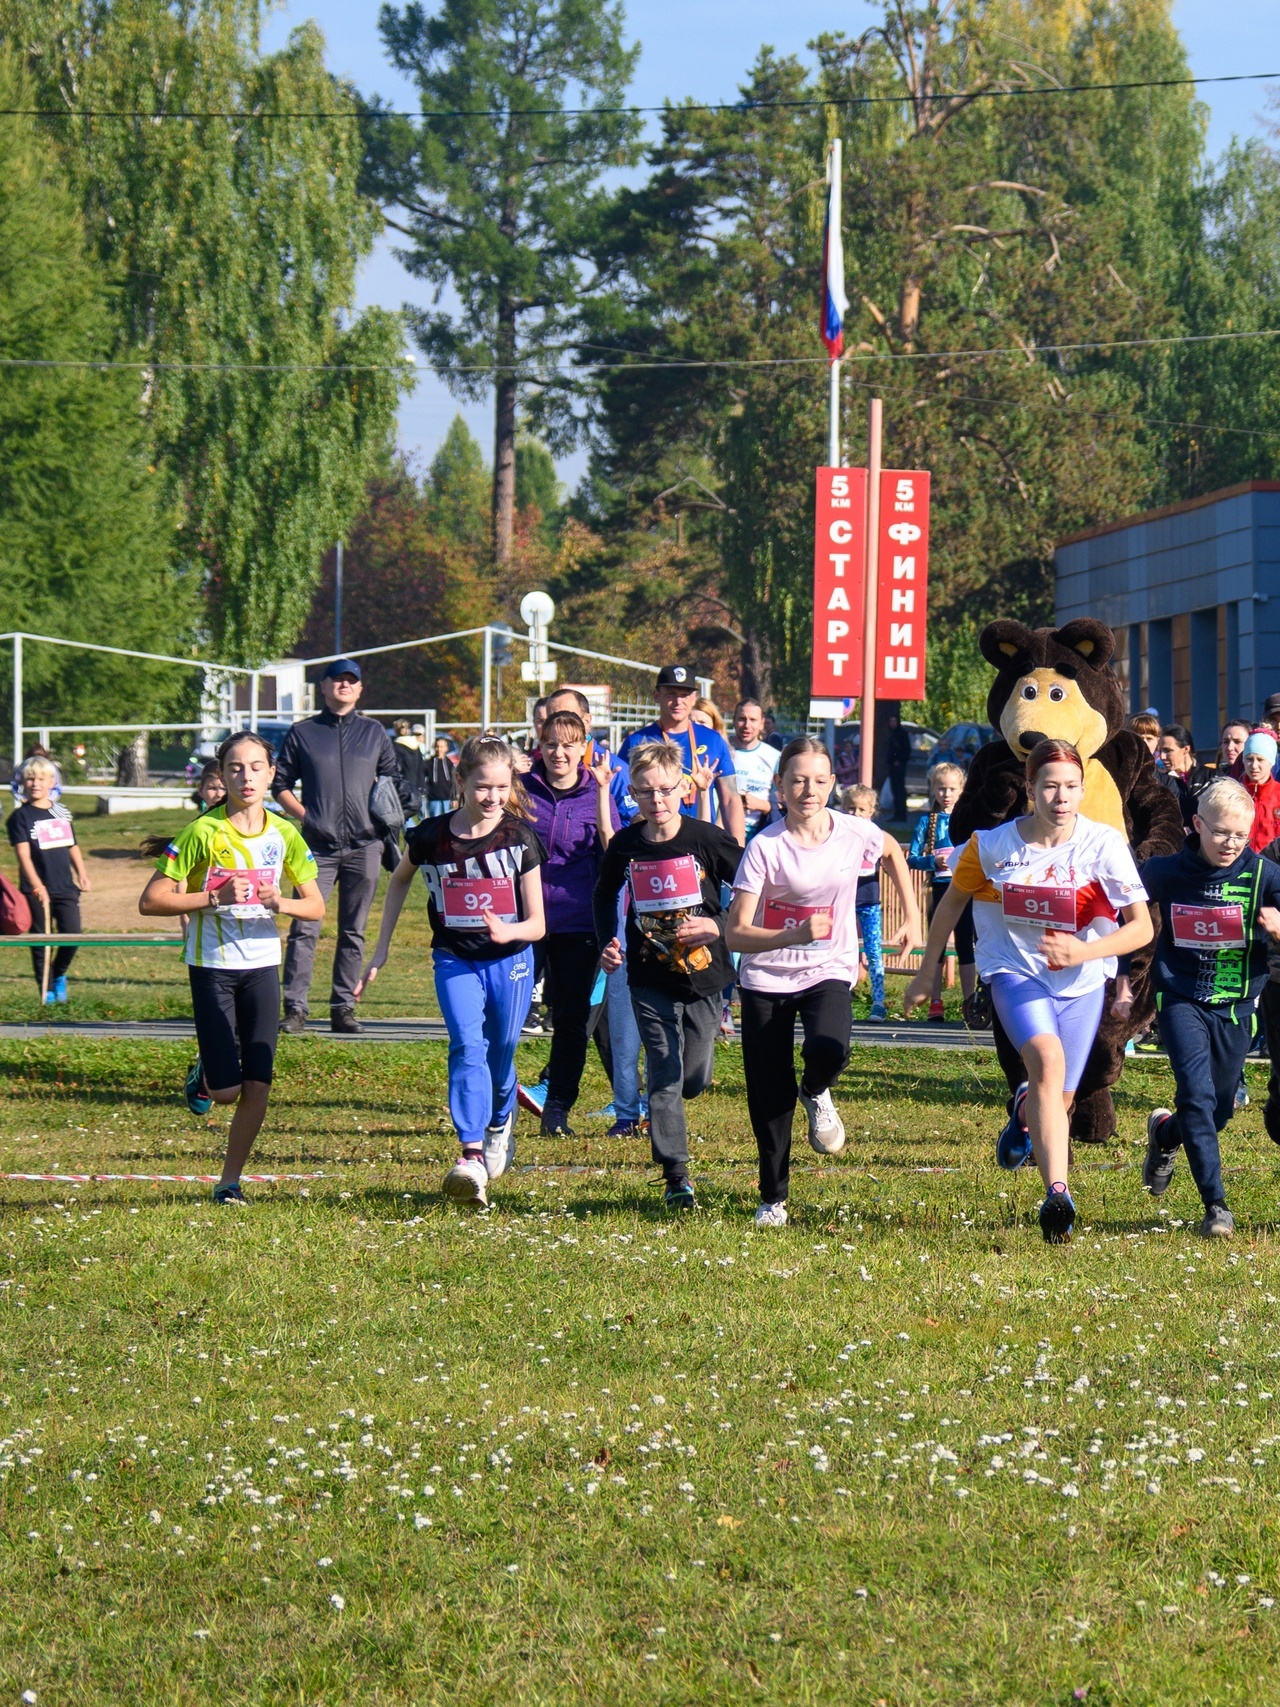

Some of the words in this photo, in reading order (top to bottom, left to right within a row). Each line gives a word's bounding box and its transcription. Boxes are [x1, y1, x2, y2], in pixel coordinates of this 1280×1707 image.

[831, 475, 848, 497] 5
[896, 479, 914, 501] 5
[827, 520, 852, 676] СТАРТ
[884, 522, 921, 680] ФИНИШ
[650, 874, 677, 893] 94
[464, 893, 493, 910] 92
[1024, 899, 1054, 916] 91
[1194, 921, 1223, 936] 81
